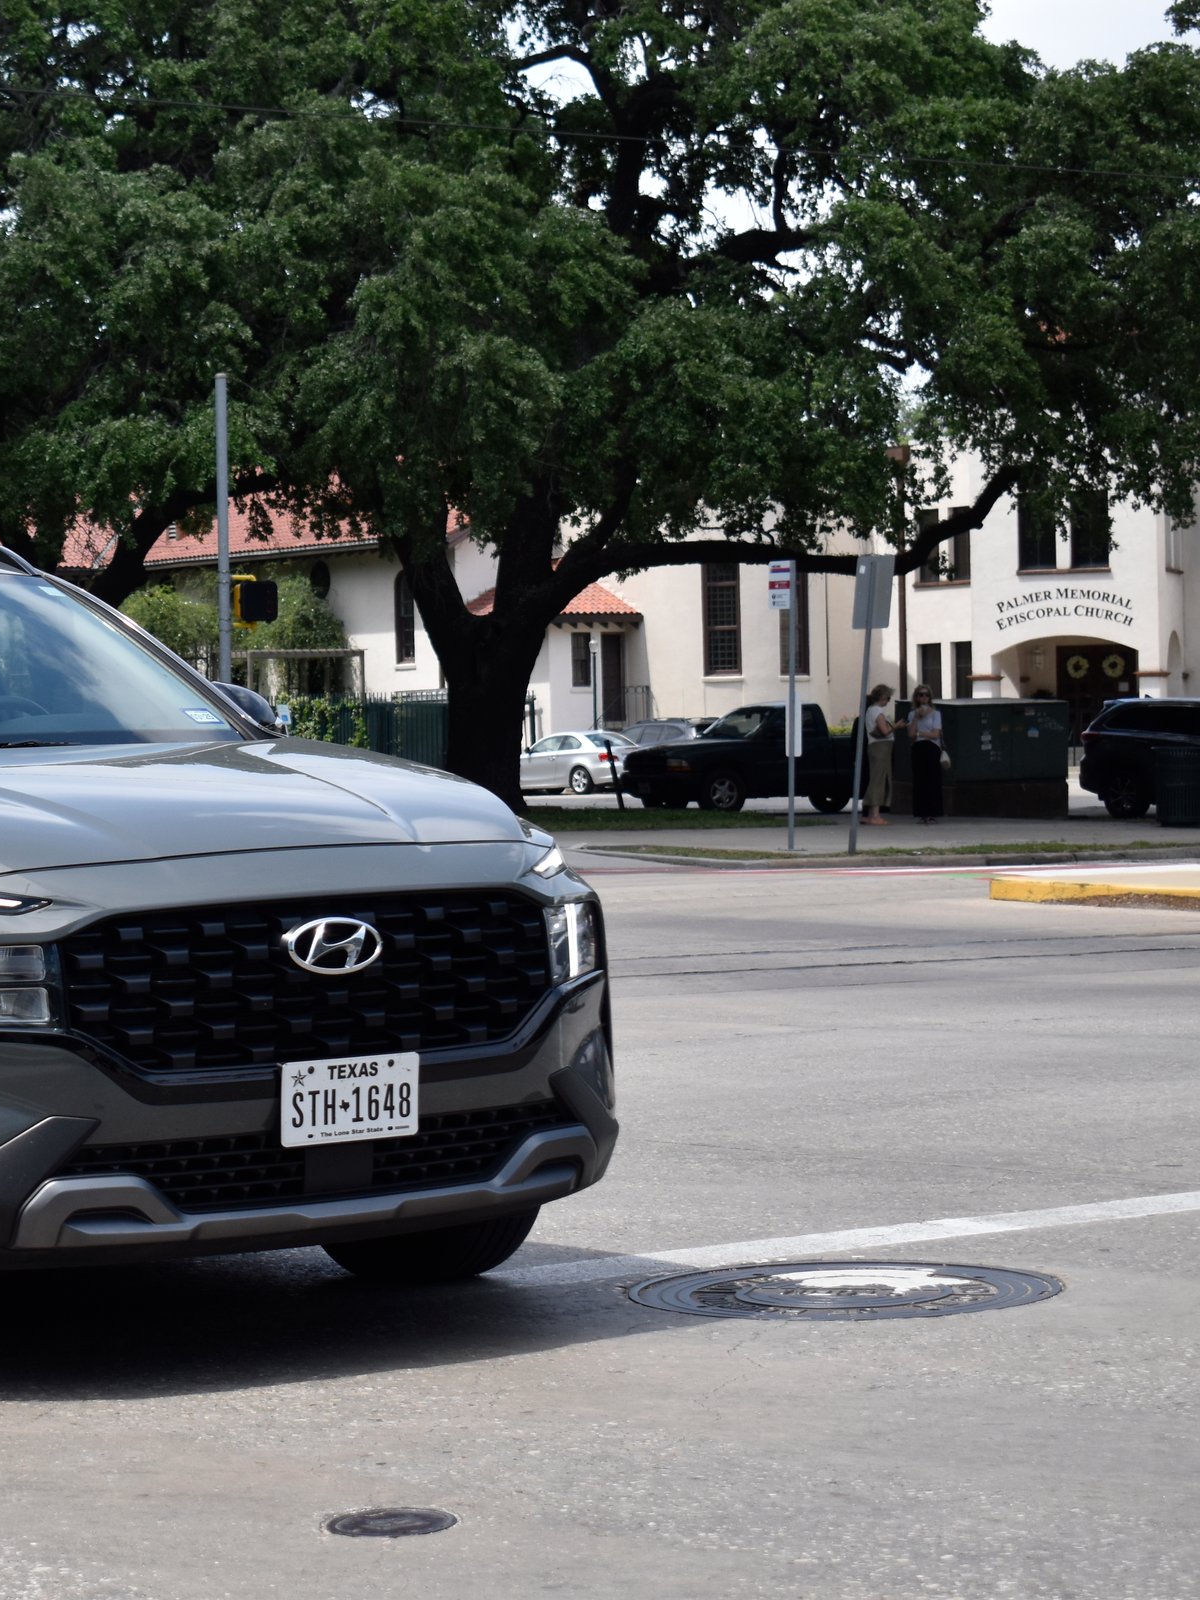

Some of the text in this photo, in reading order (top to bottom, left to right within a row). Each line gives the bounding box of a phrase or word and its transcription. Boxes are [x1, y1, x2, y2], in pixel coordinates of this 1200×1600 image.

[996, 588, 1133, 613] PALMER MEMORIAL
[996, 604, 1134, 631] EPISCOPAL CHURCH
[328, 1061, 379, 1080] TEXAS
